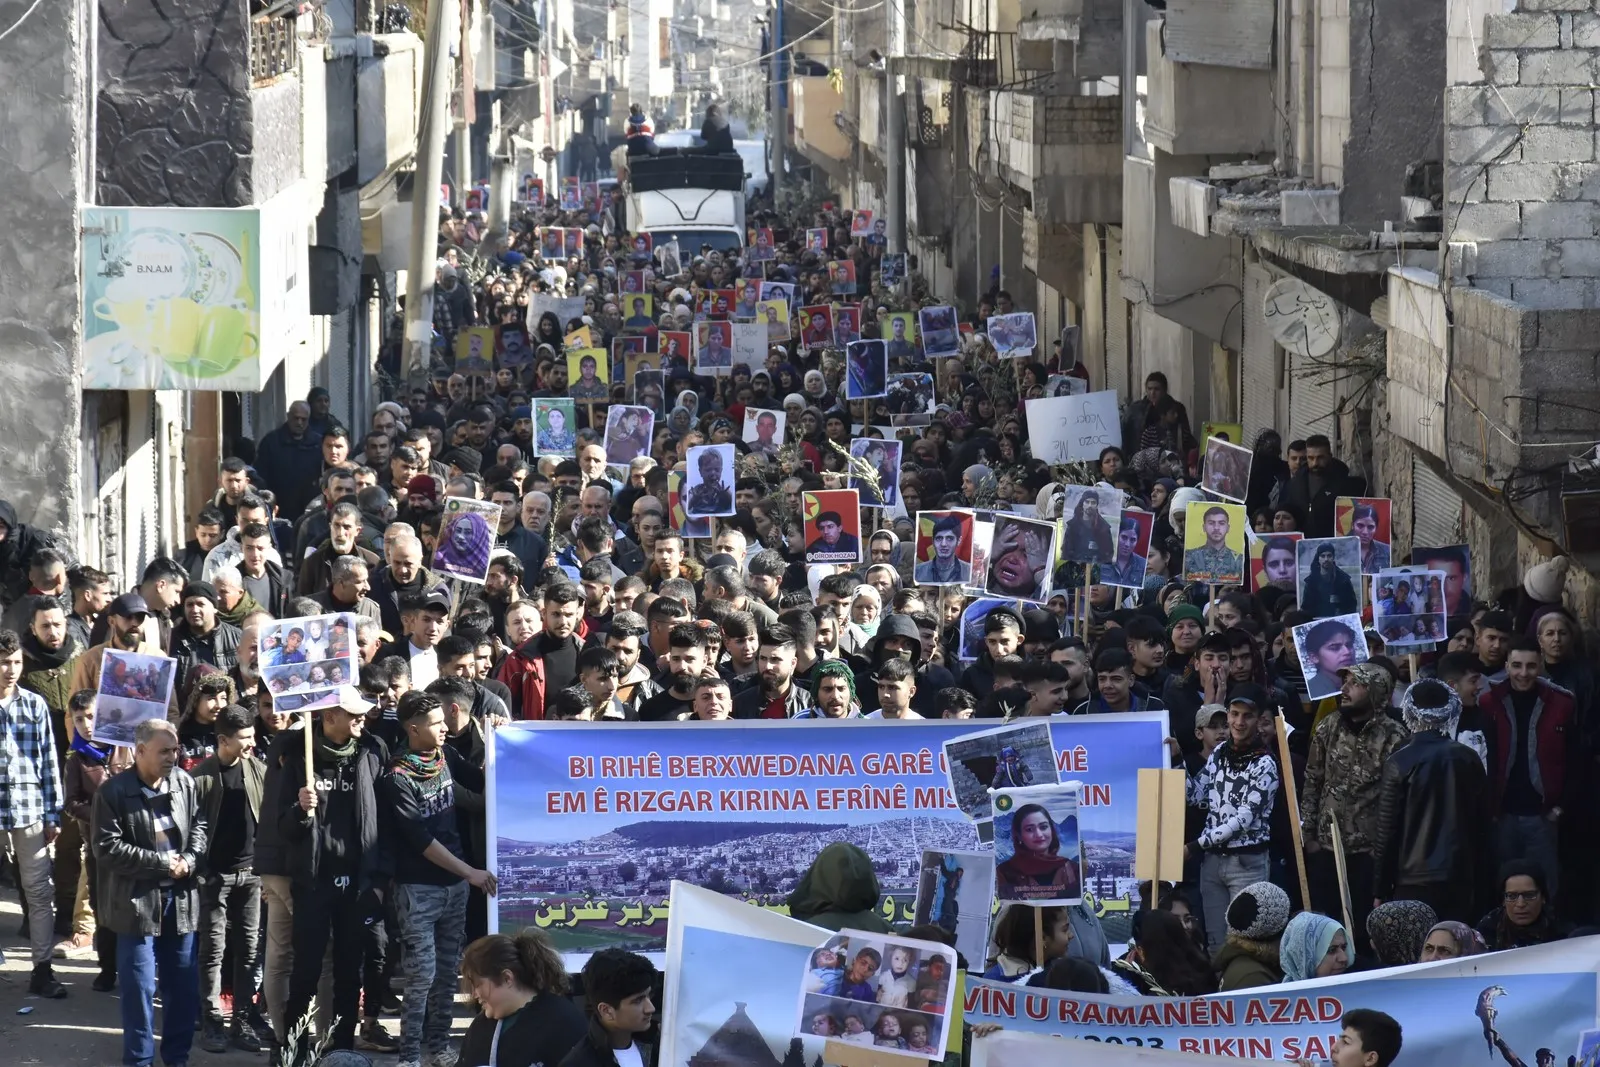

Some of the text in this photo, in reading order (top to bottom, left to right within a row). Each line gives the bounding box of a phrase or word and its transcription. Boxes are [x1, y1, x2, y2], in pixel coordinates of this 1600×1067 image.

[136, 264, 173, 274] B.N.A.M
[1052, 440, 1069, 460] Me
[834, 551, 856, 560] HOZAN
[568, 755, 594, 779] BI
[601, 752, 662, 778] RIHÊ
[668, 754, 856, 777] BERXWEDANA
[861, 747, 934, 775] GARÊ
[546, 792, 586, 815] EM
[593, 786, 609, 814] Ê
[615, 790, 713, 813] RIZGAR
[719, 788, 811, 812] KIRINA
[815, 782, 907, 810] EFRÎNÊ
[534, 893, 610, 928] عفرين
[962, 984, 1344, 1027] VÎN U RAMANÊN AZAD
[1178, 1037, 1274, 1060] BIKIN
